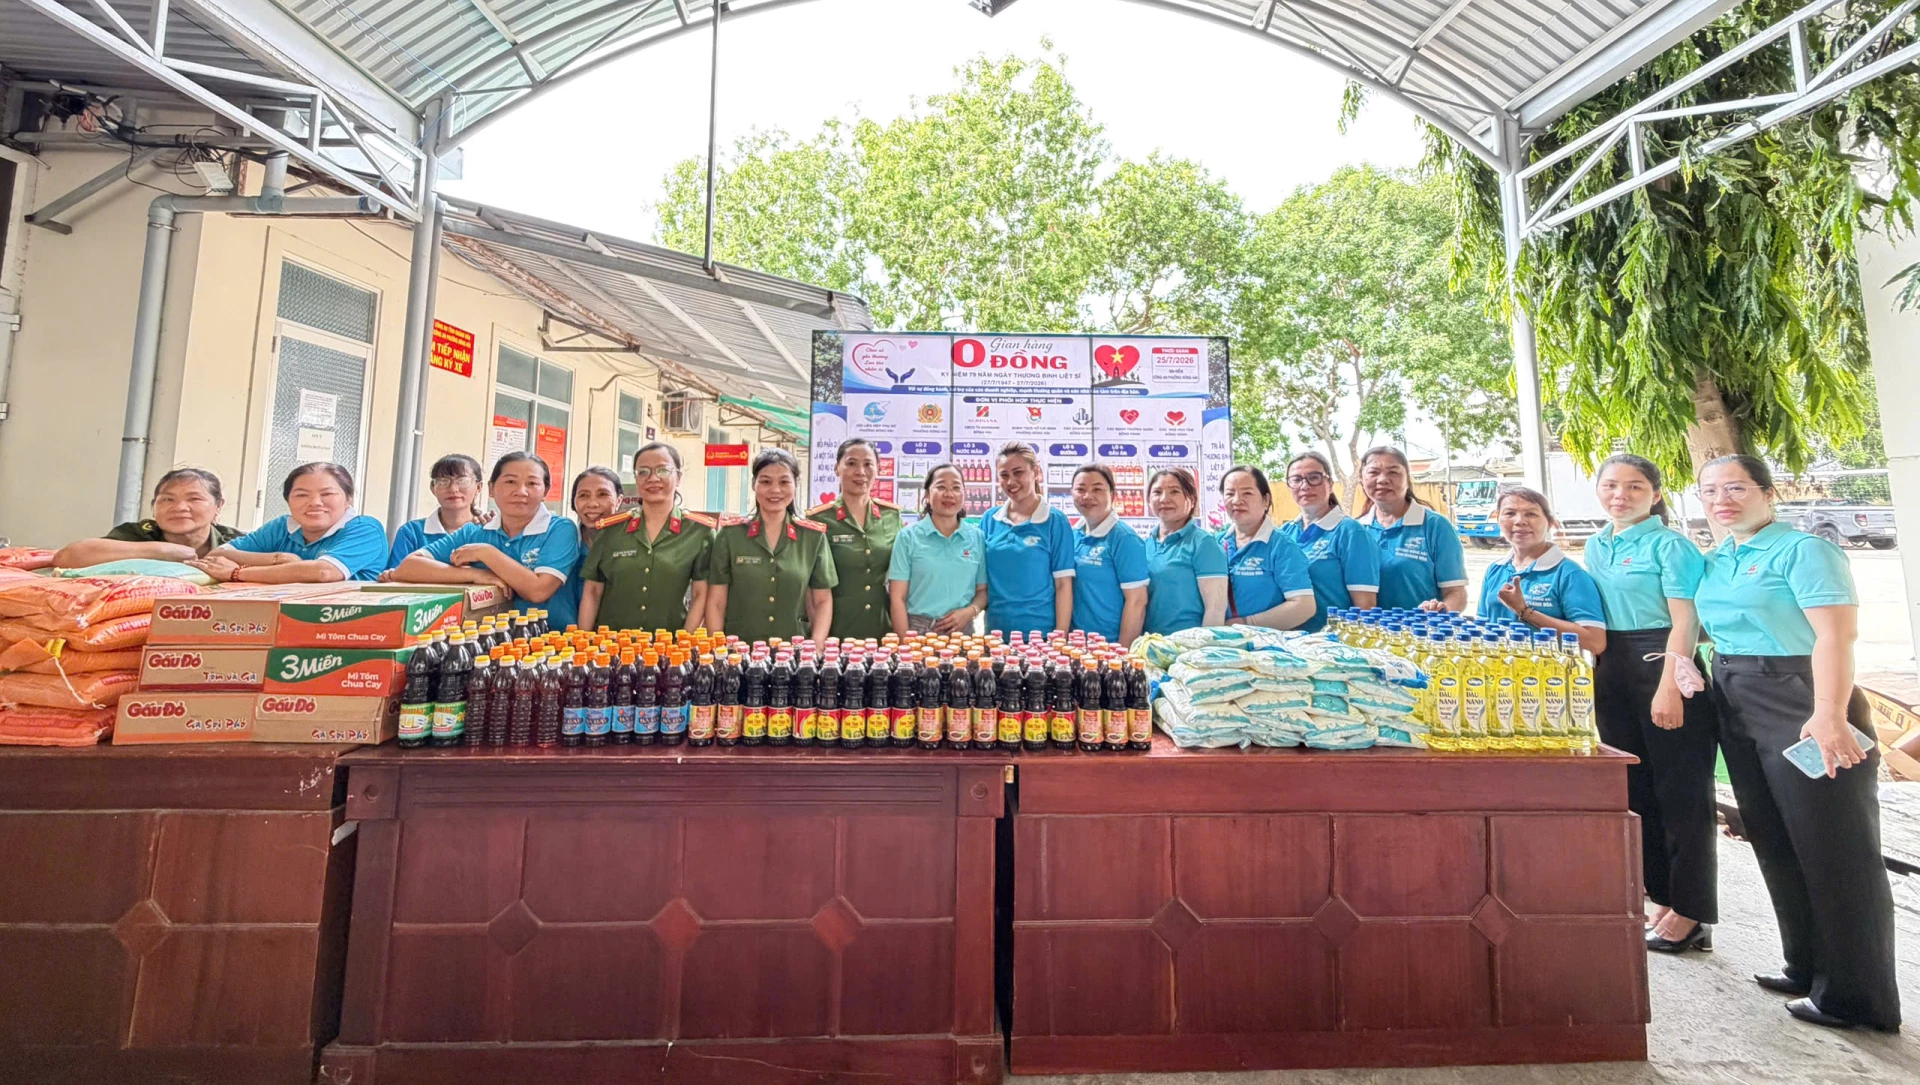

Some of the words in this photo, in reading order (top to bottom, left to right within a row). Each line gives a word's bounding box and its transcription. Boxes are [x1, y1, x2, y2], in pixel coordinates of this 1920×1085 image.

[437, 342, 452, 356] TIẾP
[453, 348, 470, 364] NHẬN
[990, 337, 1020, 352] Gian
[1024, 338, 1054, 354] hàng
[950, 339, 986, 368] 0
[990, 350, 1068, 370] ĐỒNG
[1156, 356, 1194, 364] 25/7/2026
[454, 362, 463, 373] XE
[159, 604, 190, 620] Gấu
[191, 605, 212, 620] Đỏ
[320, 606, 332, 622] 3
[331, 605, 362, 622] Miền
[212, 622, 226, 632] Gà
[229, 622, 244, 633] Sợi
[248, 622, 267, 632] Phở
[316, 632, 326, 640] Mì
[370, 634, 386, 642] Cay
[149, 653, 180, 668] Gấu
[181, 654, 202, 668] Đỏ
[280, 654, 300, 679] 3
[297, 654, 342, 679] Miền
[203, 671, 223, 680] Tôm
[227, 671, 238, 680] và
[240, 672, 256, 681] Gà
[360, 672, 379, 680] Tôm
[341, 680, 363, 688] Chua
[366, 681, 382, 689] Cay
[127, 702, 161, 717] Gấu
[163, 701, 186, 717] Đỏ
[262, 697, 294, 712] Gấu
[295, 697, 316, 713] Đỏ
[186, 719, 202, 729] Gà
[205, 719, 222, 731] Sợi
[225, 718, 246, 728] Phở
[312, 730, 326, 738] Gà
[329, 730, 344, 740] Sợi
[348, 729, 368, 739] Phở
